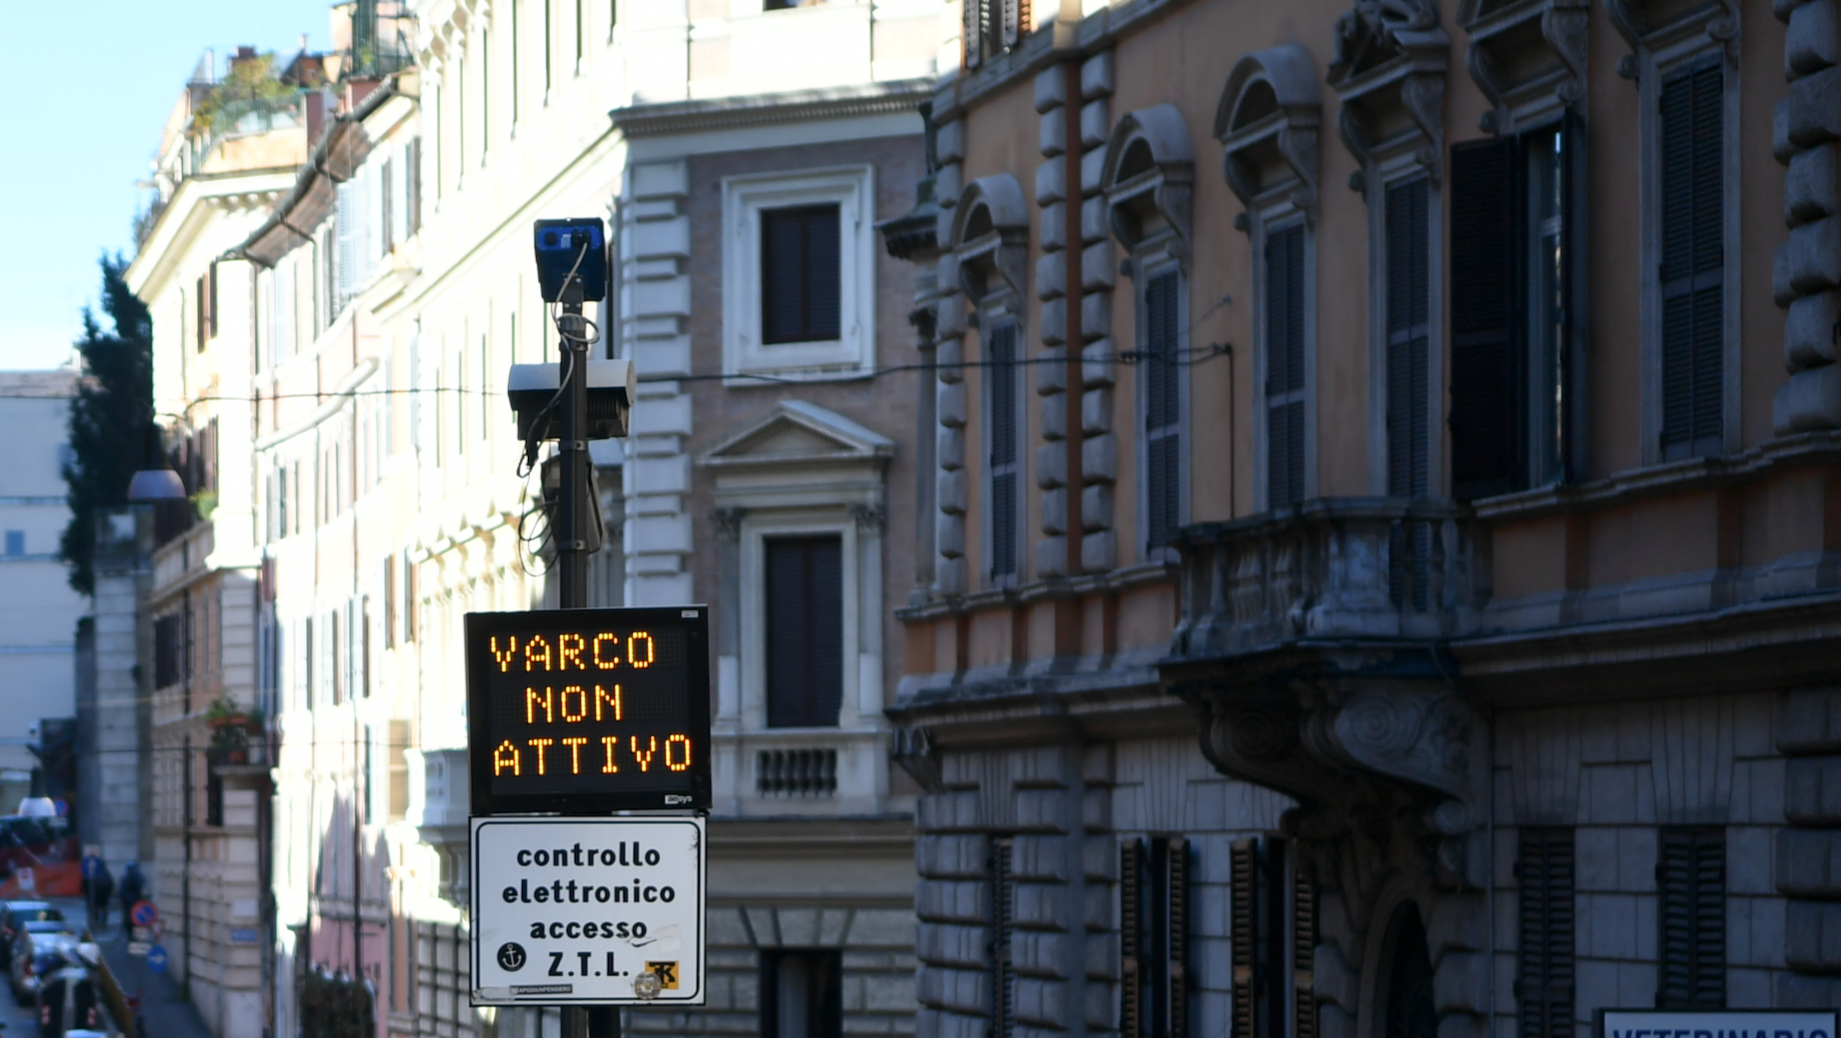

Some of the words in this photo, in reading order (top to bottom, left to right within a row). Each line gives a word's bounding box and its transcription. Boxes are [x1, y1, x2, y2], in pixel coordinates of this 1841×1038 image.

[490, 631, 654, 672] VARCO
[526, 684, 621, 723] NON
[494, 734, 691, 776] ATTIVO
[516, 841, 661, 867] controllo
[502, 878, 676, 904] elettronico
[530, 919, 648, 940] accesso
[548, 951, 629, 977] Z.T.L.
